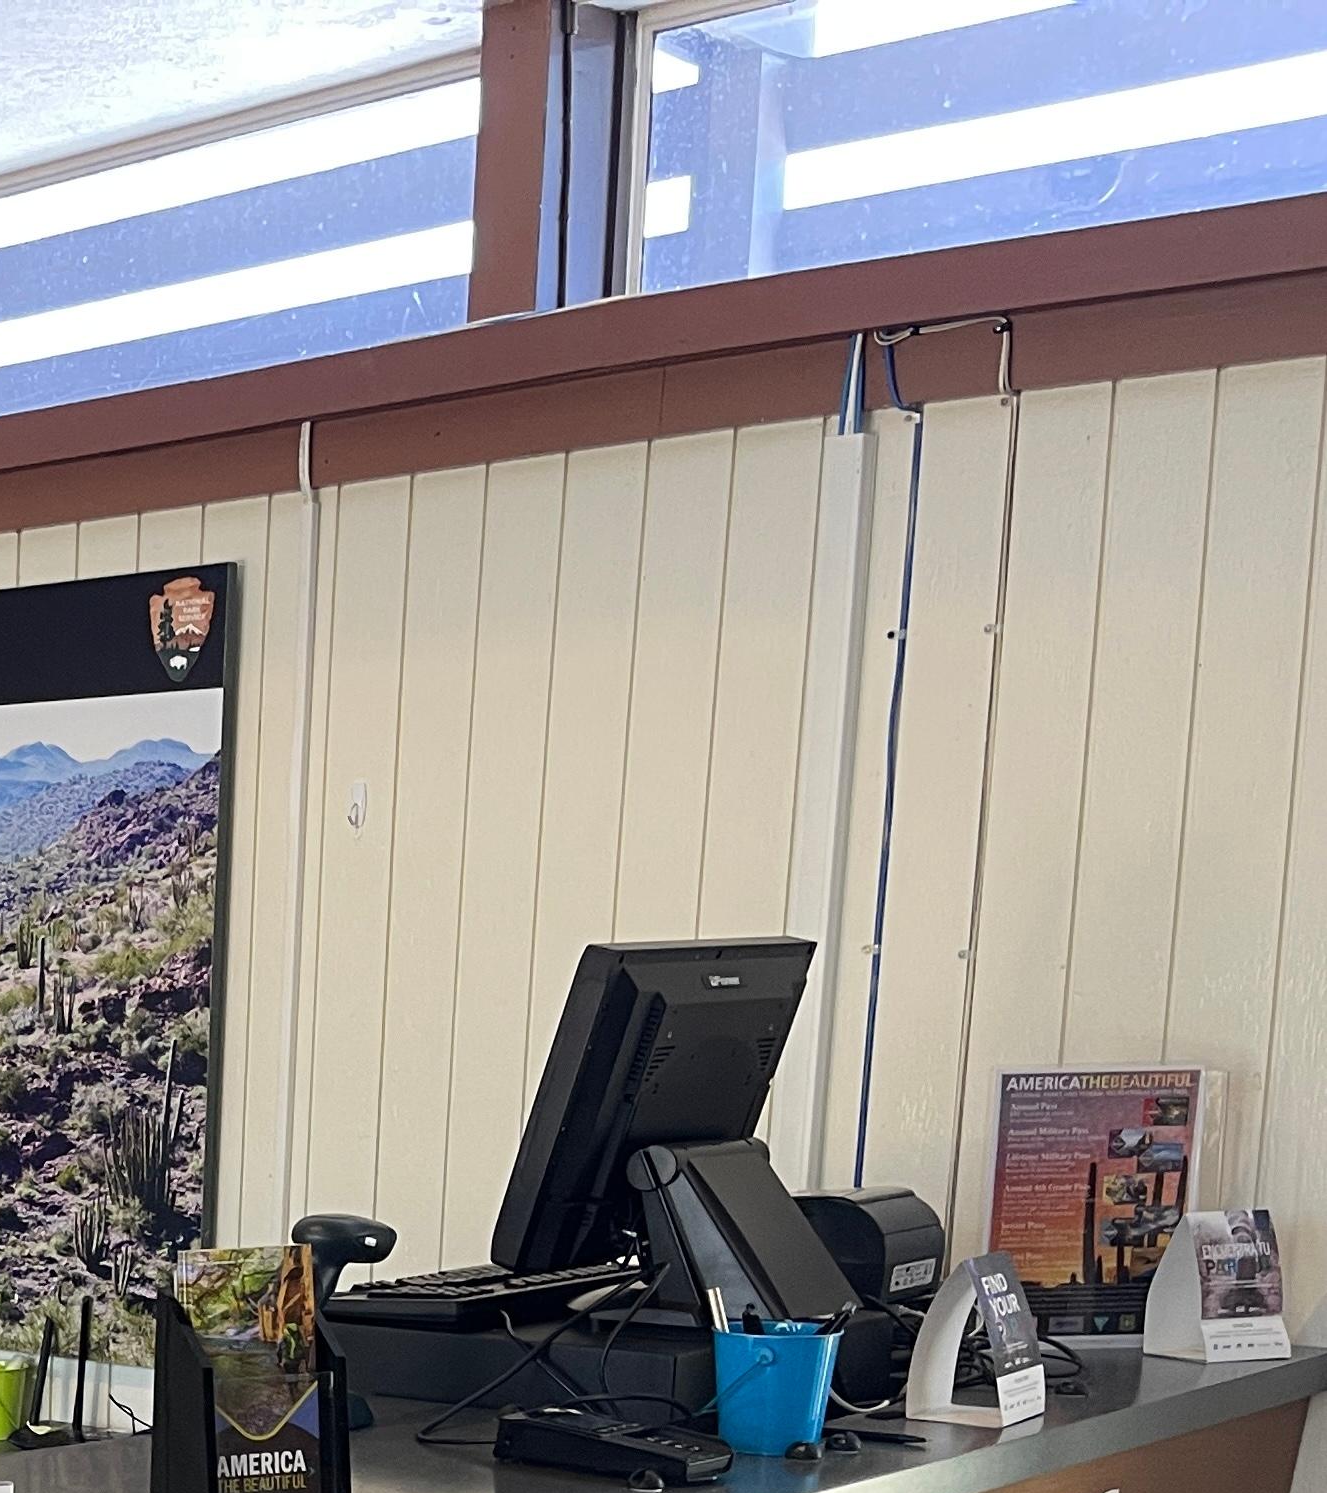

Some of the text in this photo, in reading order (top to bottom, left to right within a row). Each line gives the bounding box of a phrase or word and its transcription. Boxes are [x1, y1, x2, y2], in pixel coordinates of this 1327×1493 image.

[980, 1273, 1008, 1296] FIND
[988, 1294, 1021, 1317] YOUR
[217, 1449, 307, 1478] AMERICA
[244, 1474, 307, 1493] BEAUTIFUL
